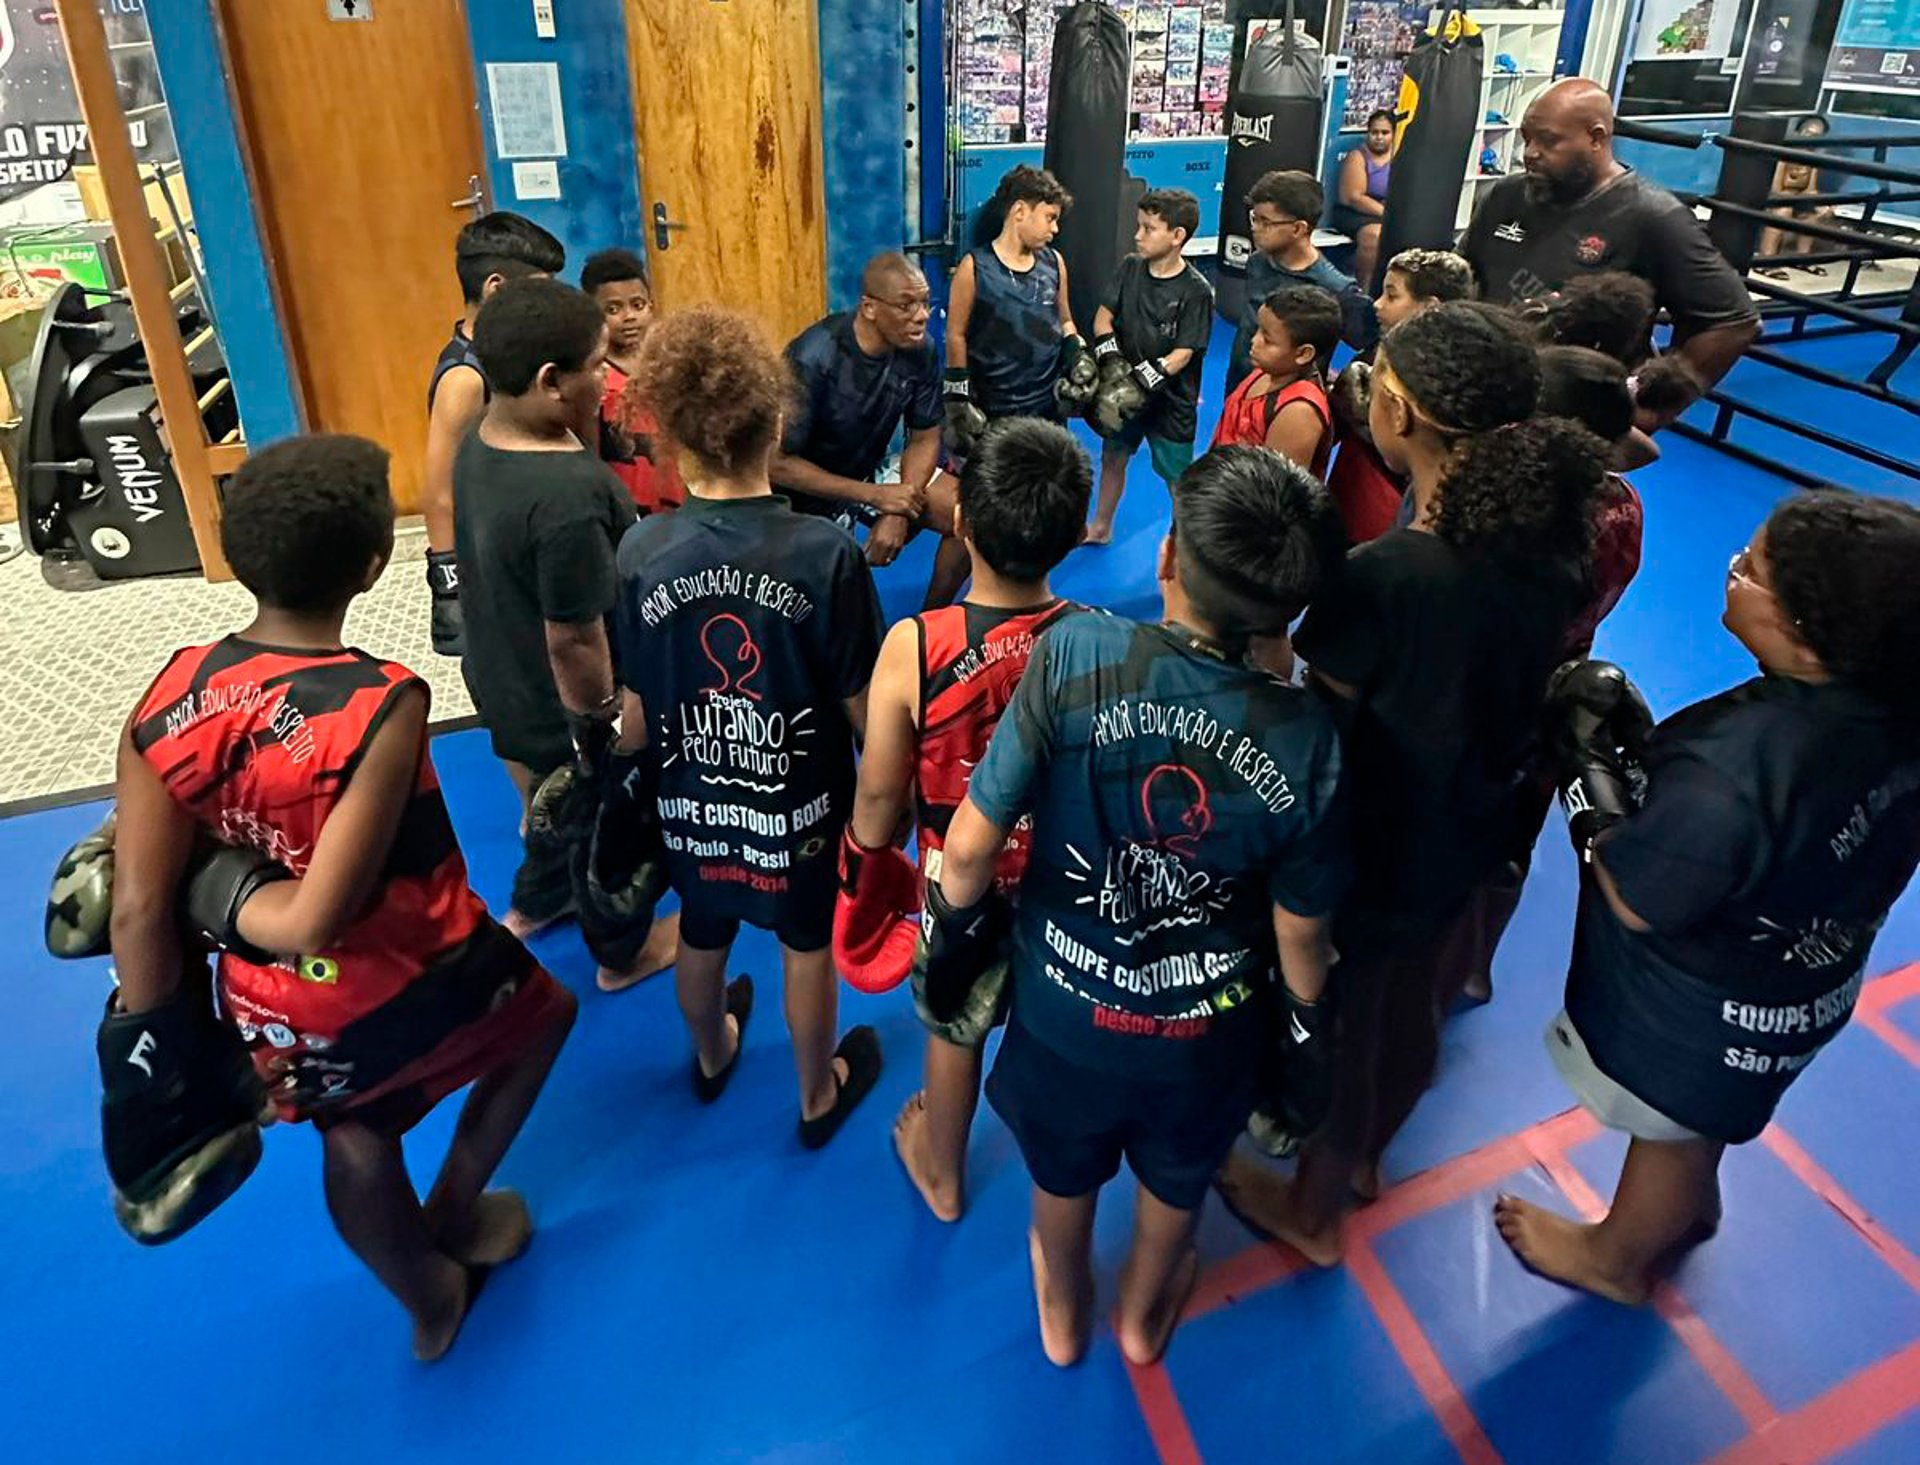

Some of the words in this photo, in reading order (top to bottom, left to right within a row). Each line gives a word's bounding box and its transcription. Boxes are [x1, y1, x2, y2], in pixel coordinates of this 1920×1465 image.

[105, 435, 164, 522] VENUM
[641, 583, 678, 627] AMOR
[673, 564, 741, 603] EDUCAÇÃO
[744, 573, 754, 599] E
[755, 574, 813, 625] RESPEITO
[953, 649, 985, 685] AMOR
[709, 689, 755, 710] Projeto
[165, 693, 199, 741] AMOR
[266, 695, 316, 765] RESPEITO
[1093, 700, 1135, 748] AMOR
[1139, 702, 1217, 749] EDUCAÇÃO
[1216, 728, 1234, 760] E
[1229, 737, 1296, 814] RESPEITO
[705, 803, 787, 837] CUSTODIO
[792, 792, 831, 832] BOXE
[686, 837, 729, 857] Paulo
[743, 844, 790, 868] Brasil
[1044, 919, 1109, 980] EQUIPE
[1722, 999, 1811, 1034] EQUIPE
[1724, 1047, 1772, 1074] São
